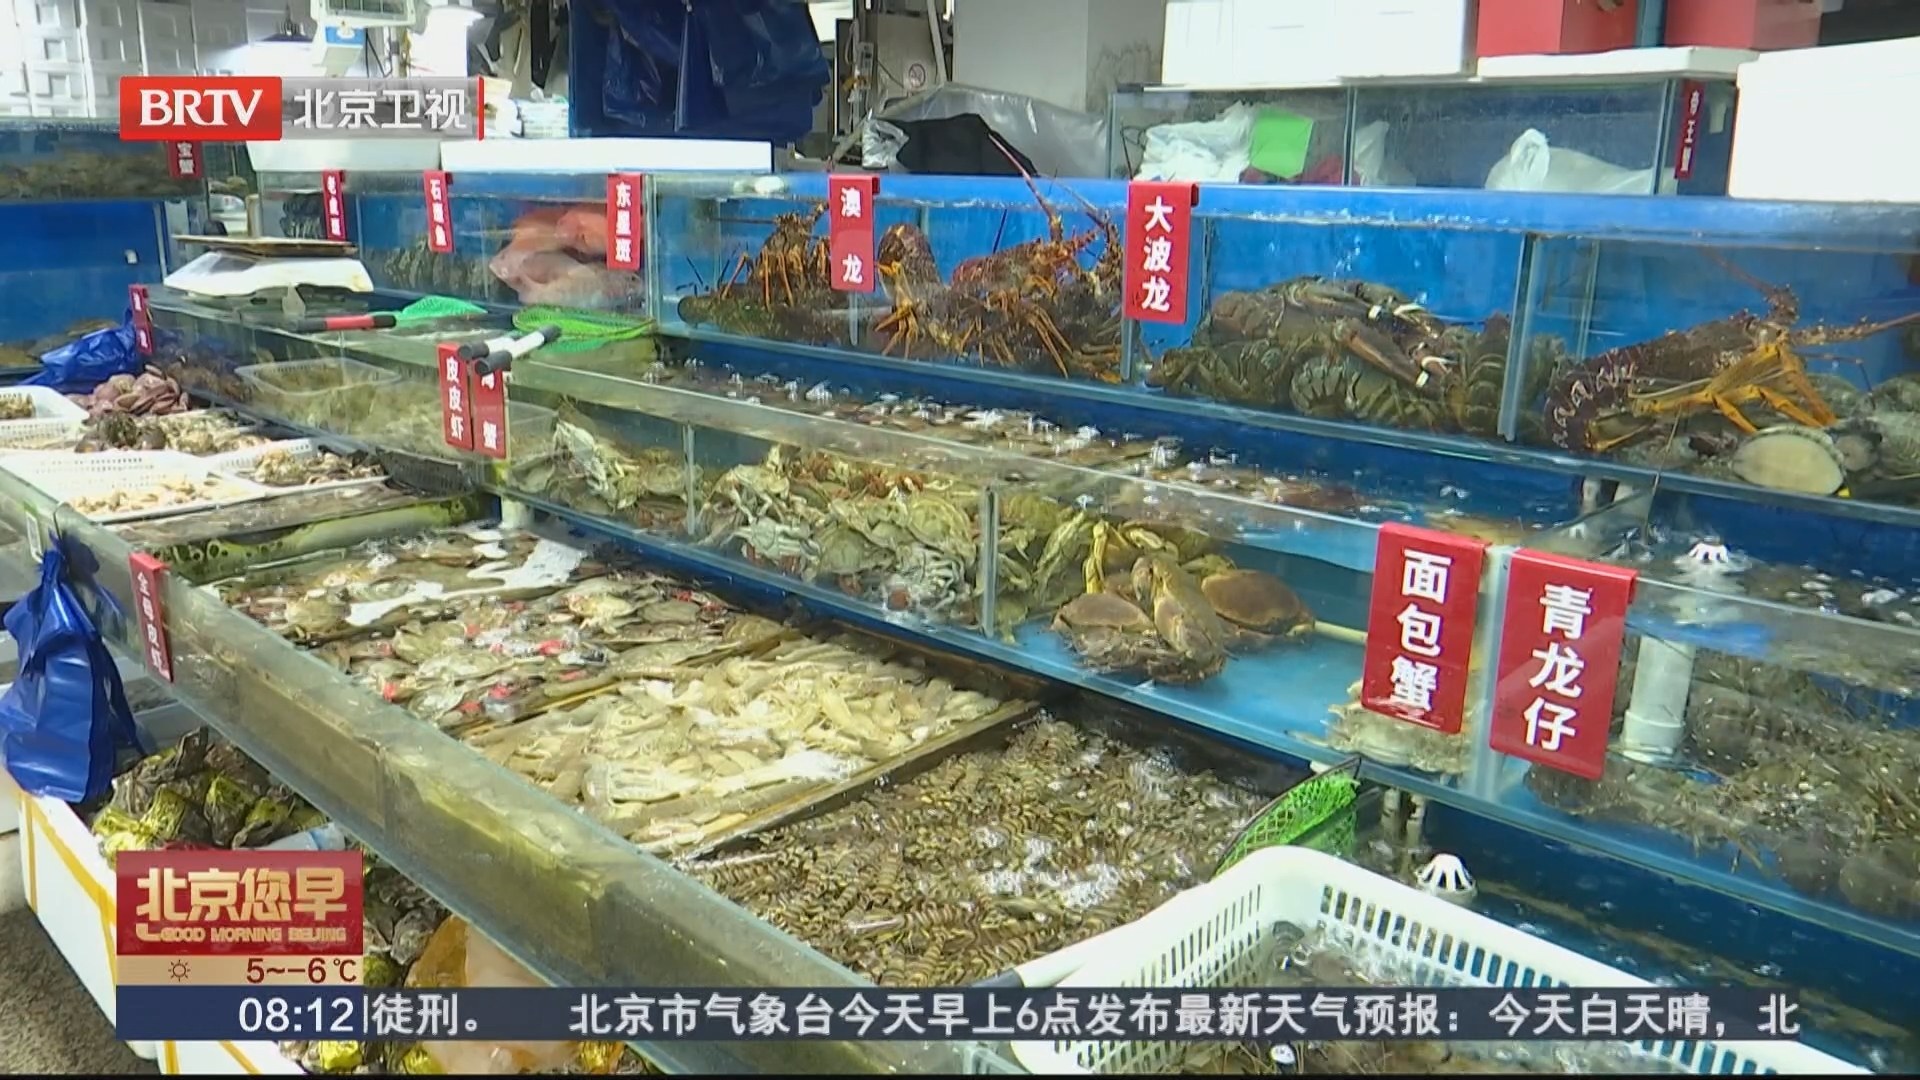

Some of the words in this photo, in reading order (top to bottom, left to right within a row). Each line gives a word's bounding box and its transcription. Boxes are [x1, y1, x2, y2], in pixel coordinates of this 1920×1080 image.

[614, 181, 632, 263] 东星斑
[840, 187, 864, 284] 澳龙
[1141, 195, 1174, 313] 大波龙
[446, 356, 464, 441] 皮皮虾
[1389, 548, 1452, 712] 面包蟹
[1523, 582, 1594, 752] 青龙仔
